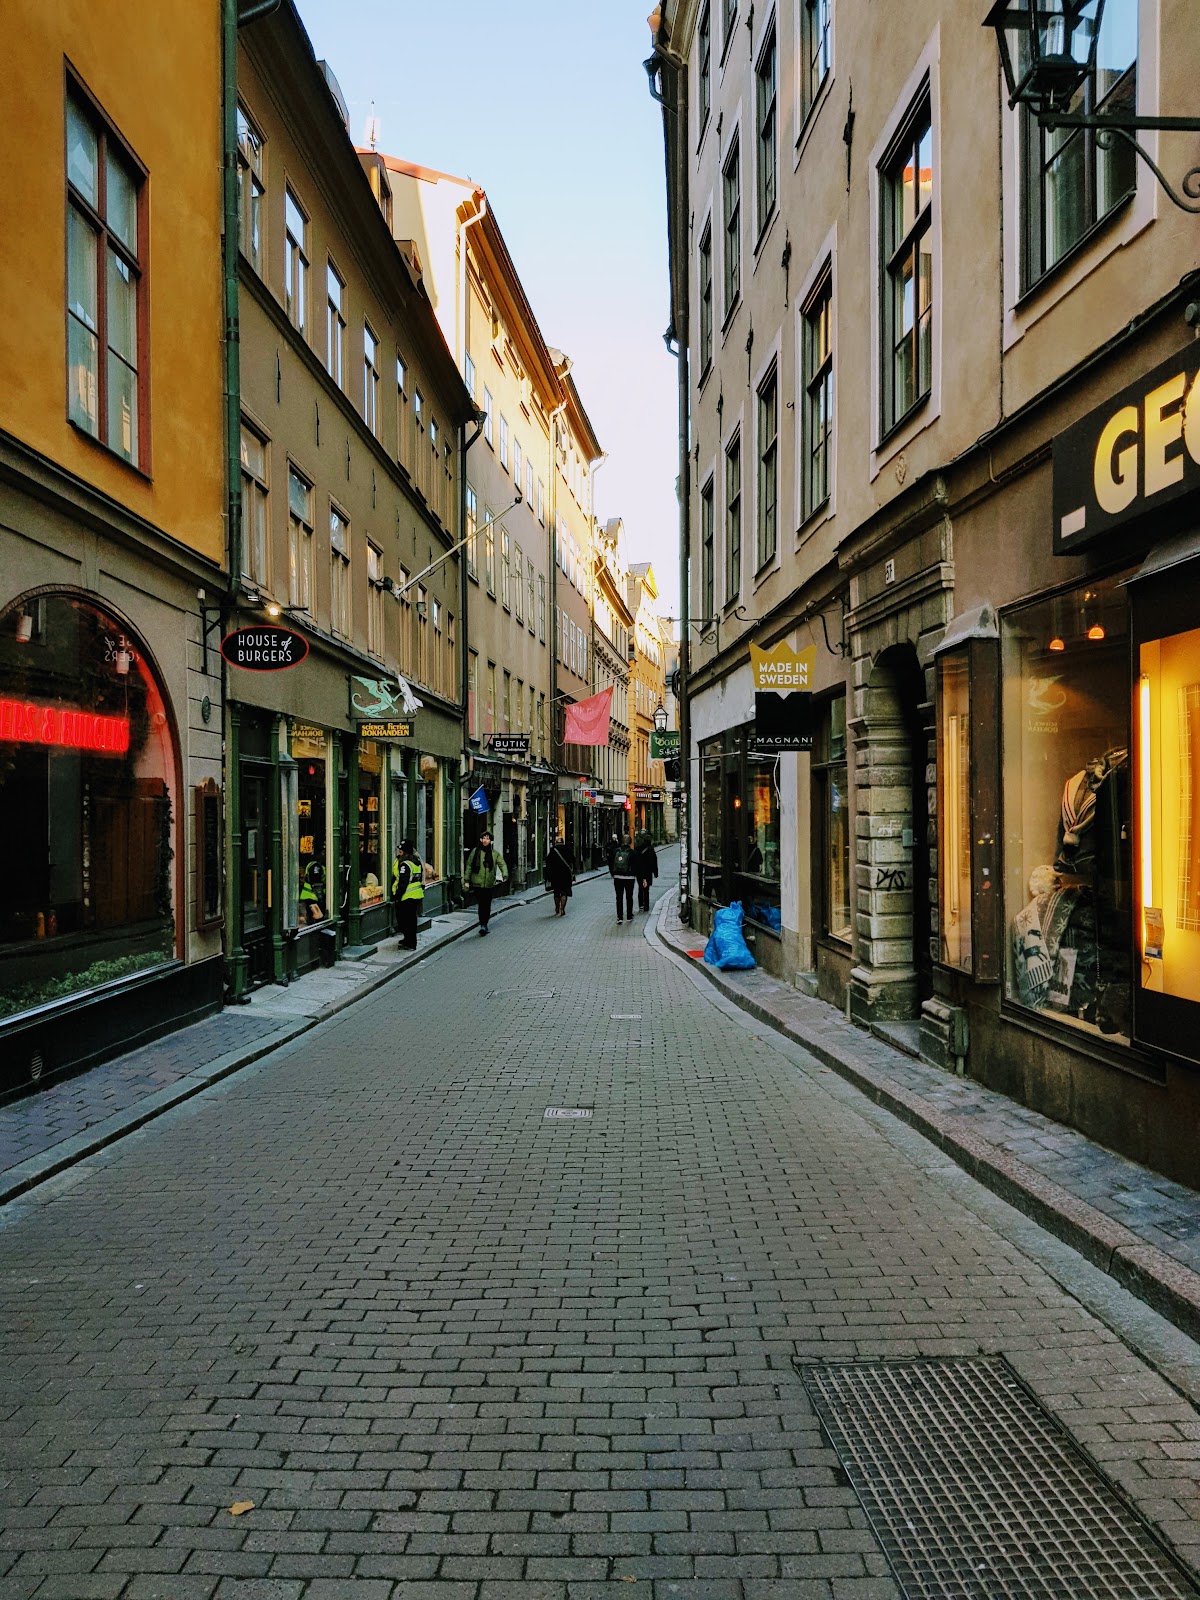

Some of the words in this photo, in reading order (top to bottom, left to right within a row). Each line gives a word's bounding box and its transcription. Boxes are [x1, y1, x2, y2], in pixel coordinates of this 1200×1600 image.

[238, 635, 278, 647] HOUSE
[281, 636, 293, 651] of
[238, 650, 292, 662] BURGERS
[759, 663, 792, 673] MADE
[795, 663, 808, 673] IN
[759, 674, 808, 685] SWEDEN
[41, 707, 55, 744] &
[60, 710, 129, 751] BURGERS
[361, 729, 410, 737] BOKHANDELN
